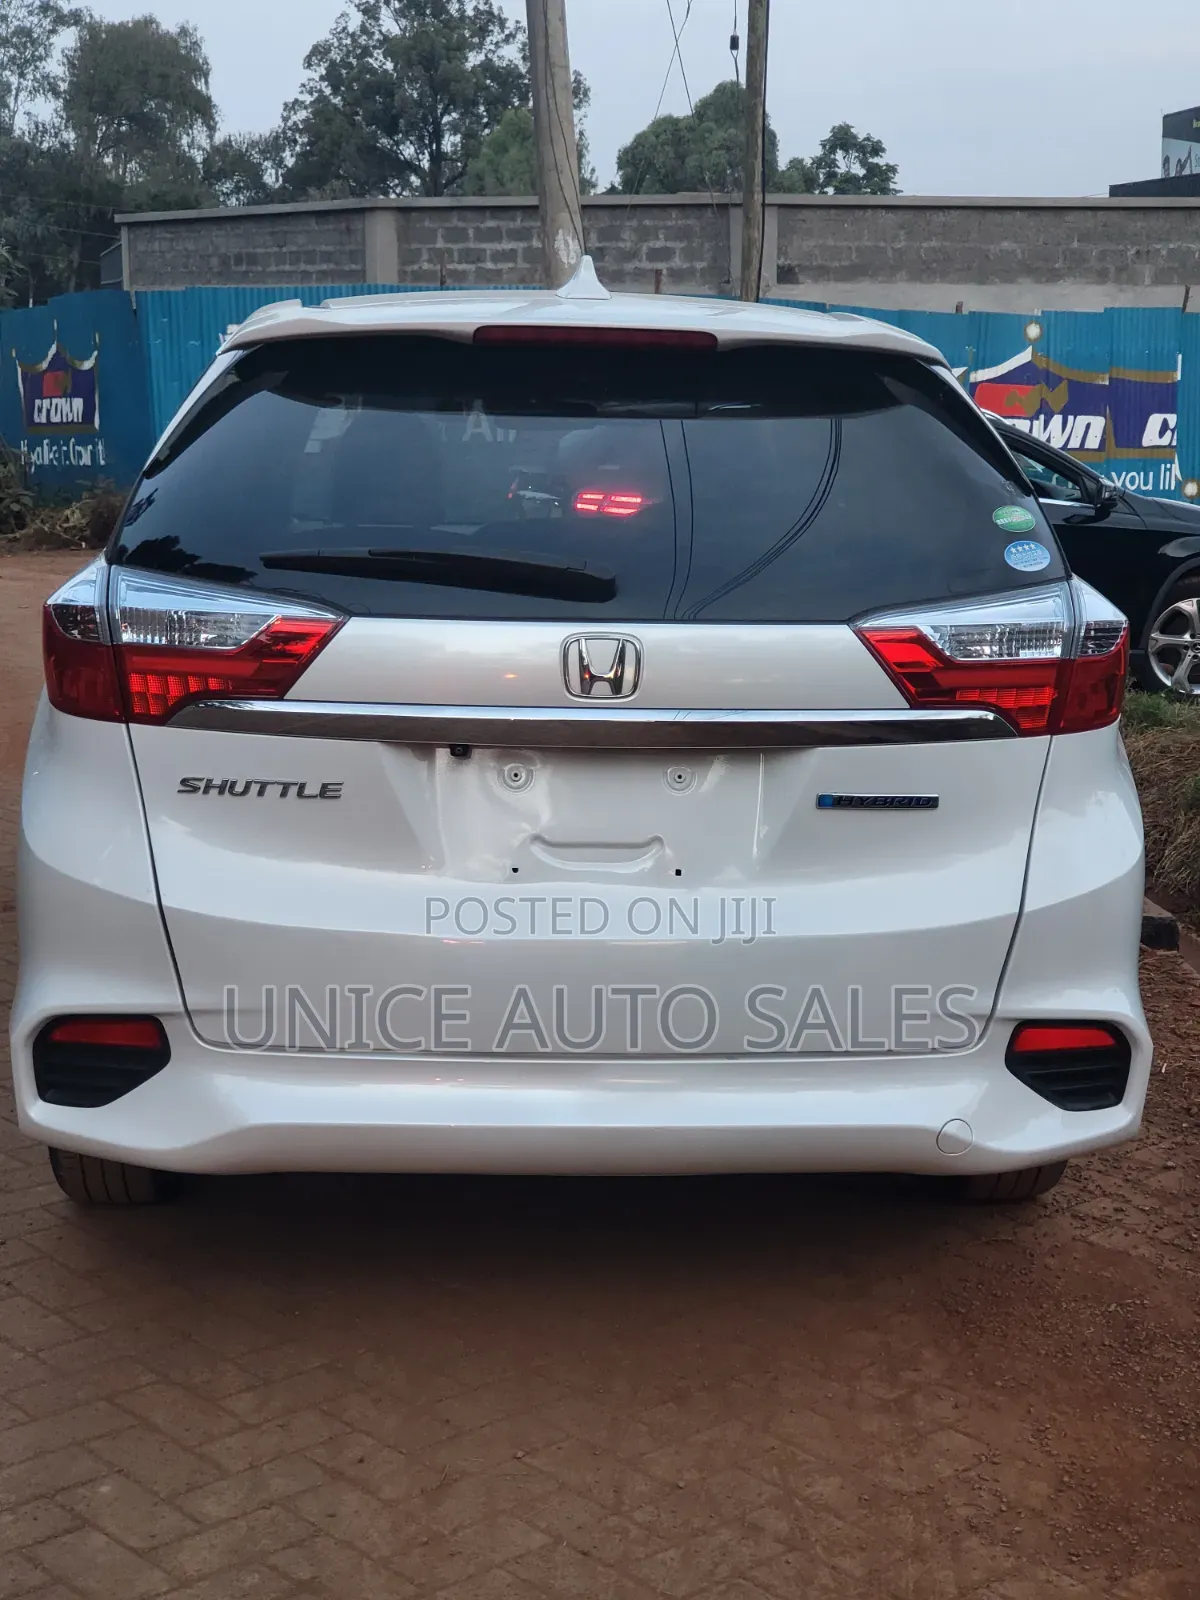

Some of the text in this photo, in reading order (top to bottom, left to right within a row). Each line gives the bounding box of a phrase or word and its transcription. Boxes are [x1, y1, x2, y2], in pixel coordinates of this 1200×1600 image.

[1110, 471, 1154, 491] you
[177, 776, 344, 799] SHUTTLE
[832, 796, 934, 807] HYBRID
